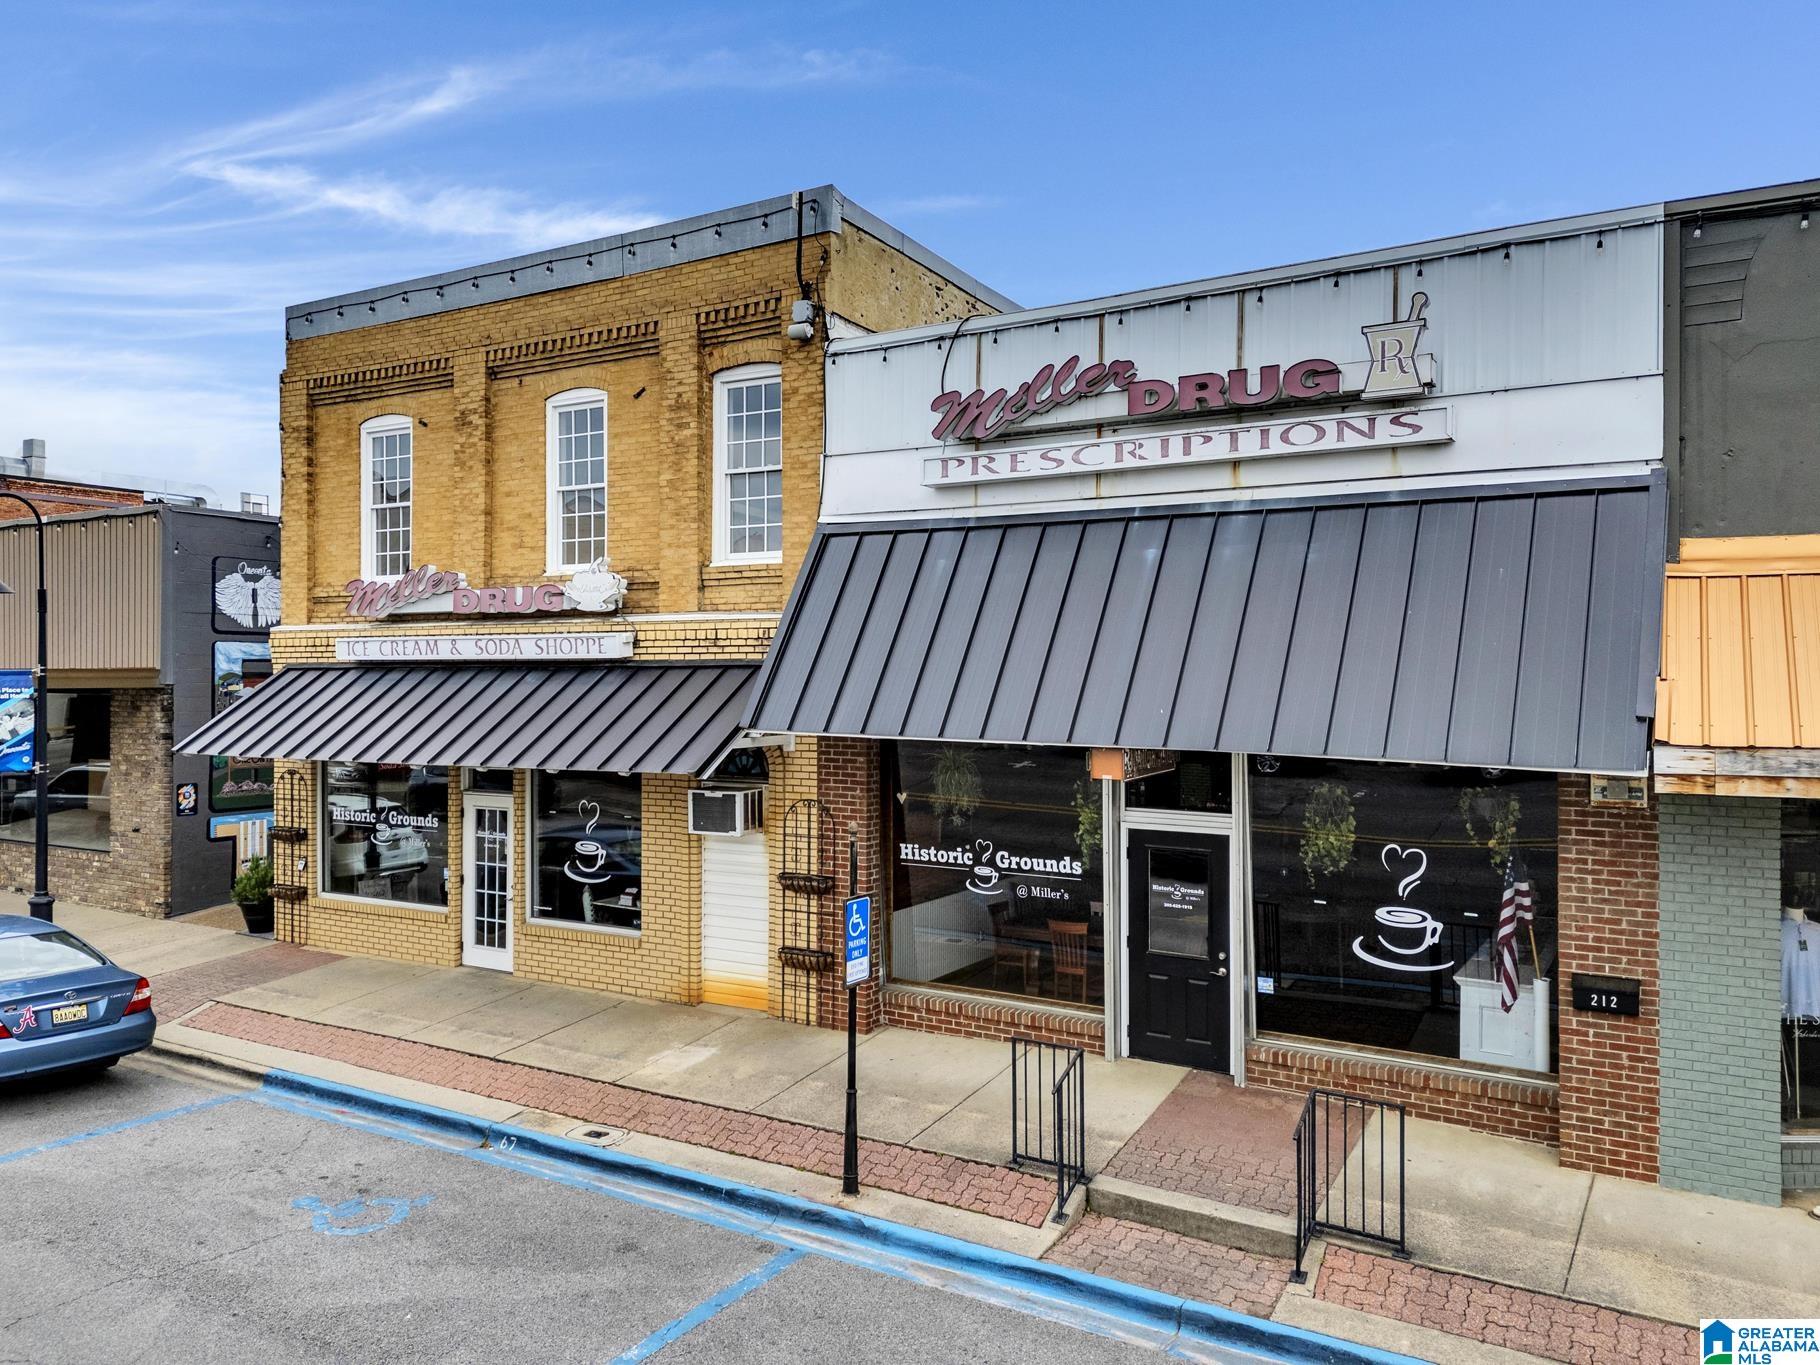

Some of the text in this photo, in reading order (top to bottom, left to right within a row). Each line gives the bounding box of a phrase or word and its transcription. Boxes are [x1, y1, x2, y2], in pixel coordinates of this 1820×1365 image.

[931, 355, 1343, 442] Miller DRUG
[939, 411, 1424, 479] PRESCRIPTIONS
[344, 563, 565, 618] Miller DRUG
[347, 637, 608, 657] ICE CREAM & SODA SHOPPE
[332, 806, 439, 828] Historic Grounds
[900, 843, 1083, 875] Historic Grounds
[1016, 884, 1070, 900] @ Miller's
[1152, 884, 1205, 895] Historic Grounds
[848, 937, 867, 949] PARKING
[851, 949, 864, 959] ONLY
[1590, 994, 1618, 1009] 212
